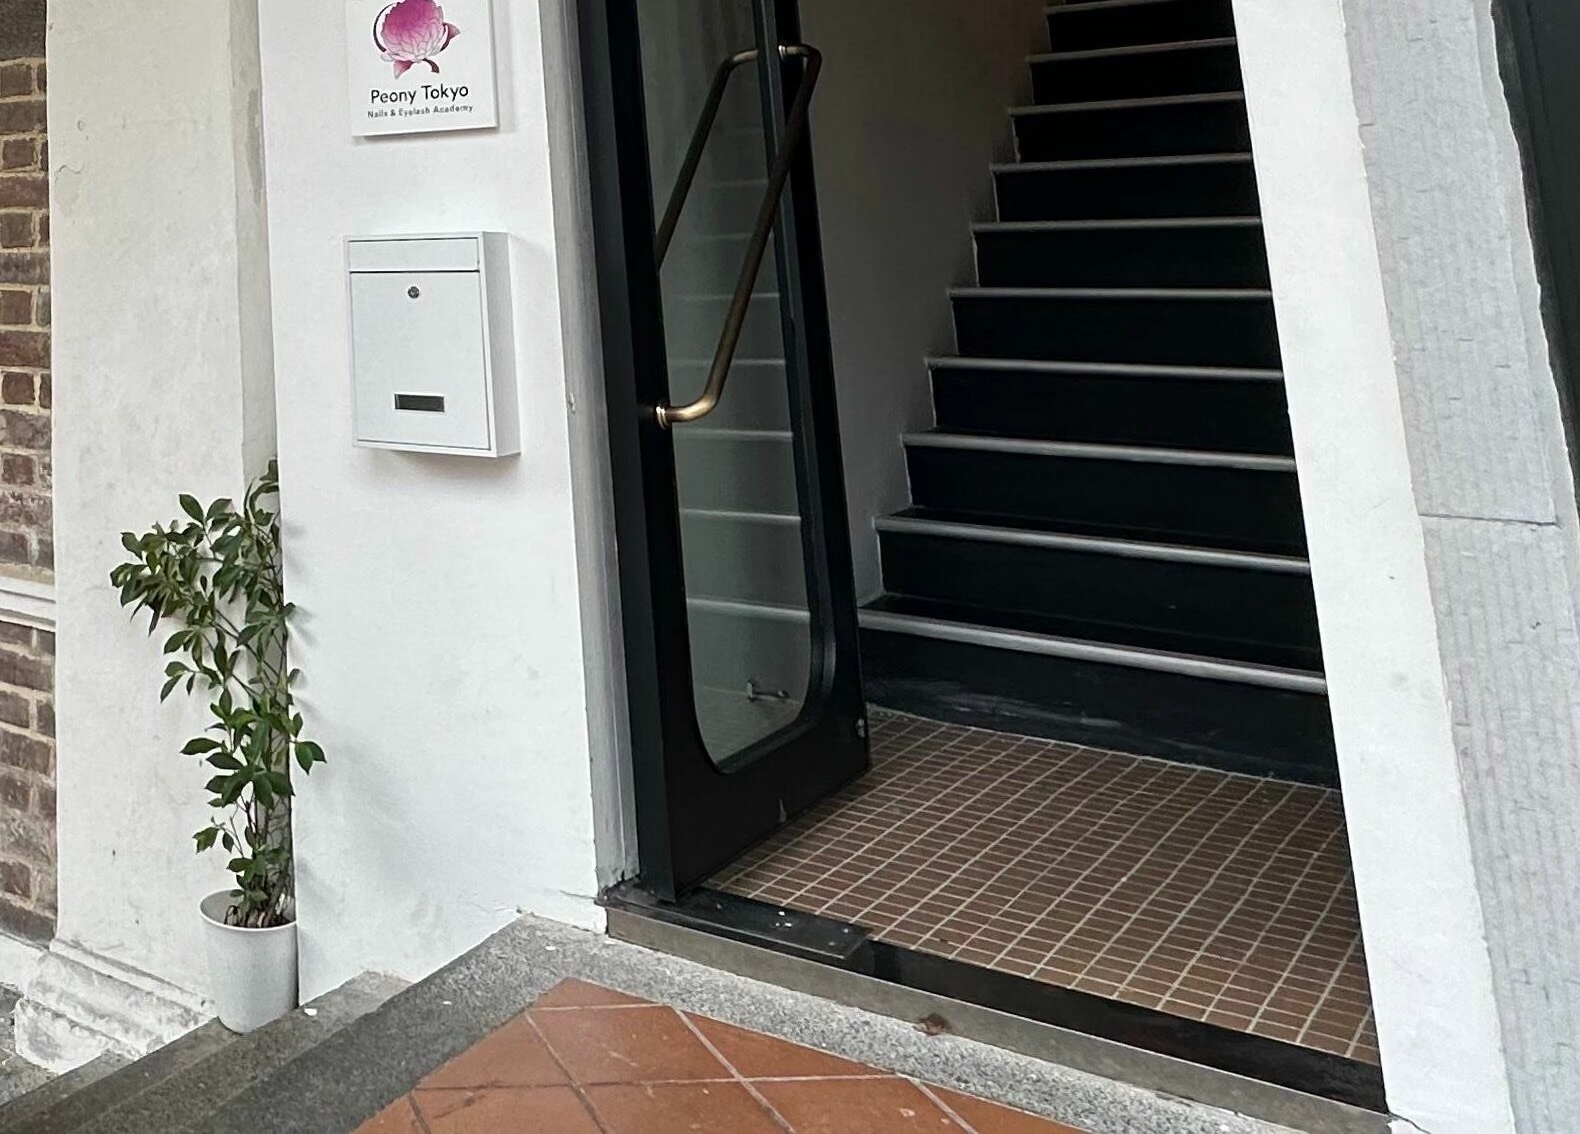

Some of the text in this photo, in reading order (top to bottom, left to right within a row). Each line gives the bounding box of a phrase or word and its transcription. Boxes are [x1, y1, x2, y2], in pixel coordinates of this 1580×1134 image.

[371, 83, 469, 104] Peony Tokyo
[368, 103, 473, 118] Nails & Eyelash Academy
